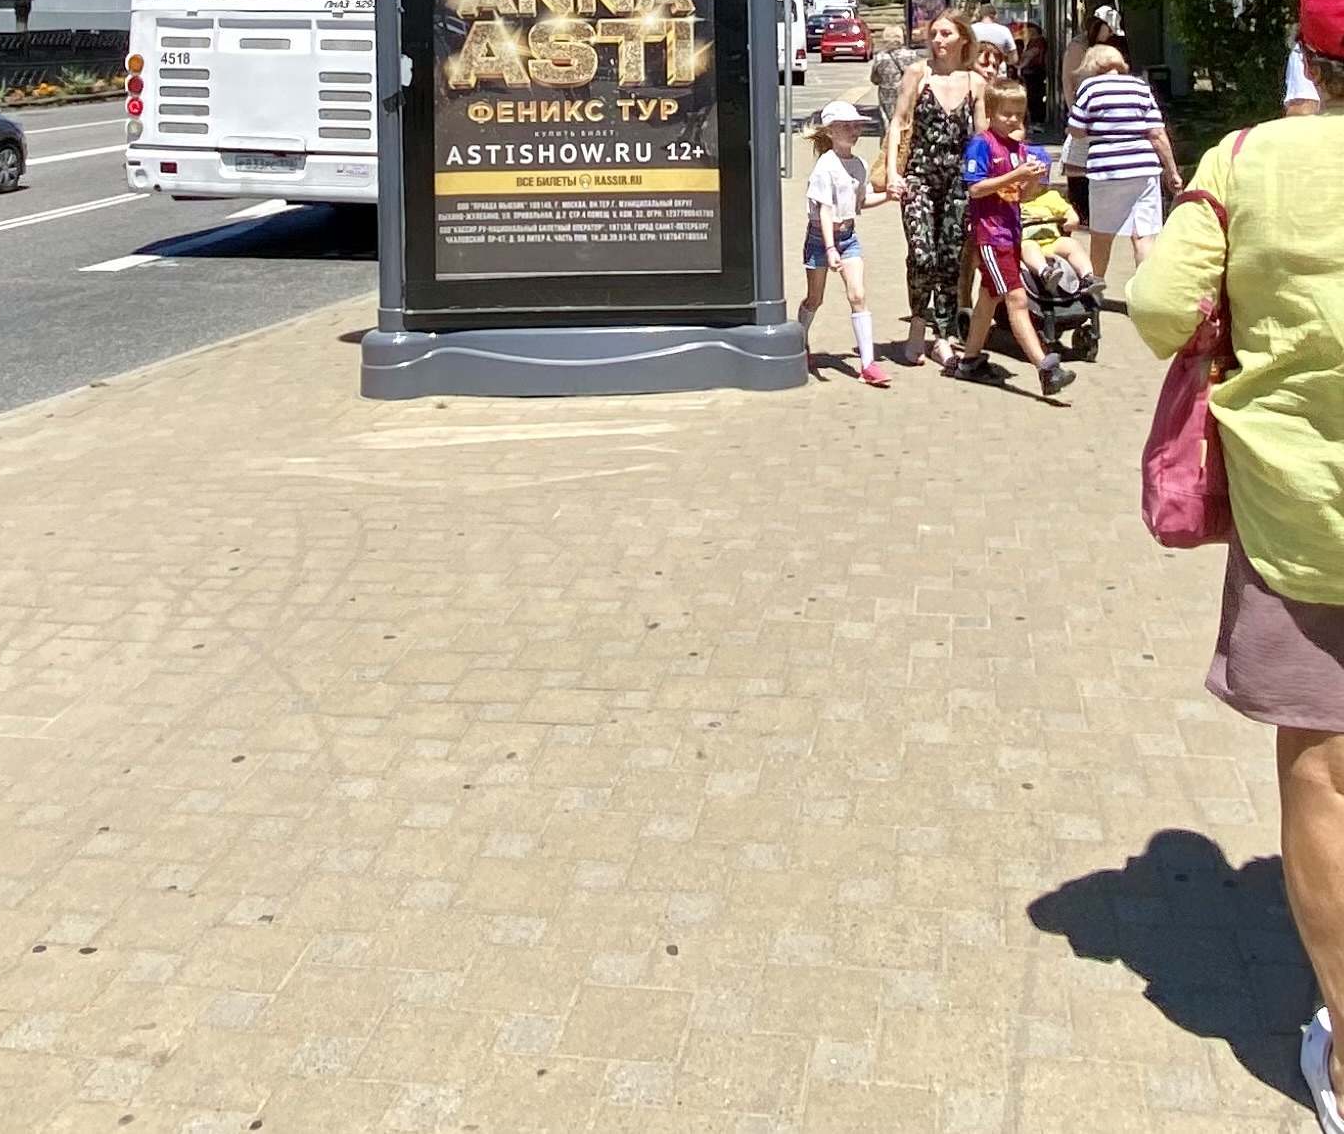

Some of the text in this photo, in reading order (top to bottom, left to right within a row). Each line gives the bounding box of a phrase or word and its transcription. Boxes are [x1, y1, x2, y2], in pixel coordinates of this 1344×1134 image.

[160, 52, 190, 65] 4518
[448, 19, 696, 89] ASTI
[467, 97, 679, 124] ФЕНИКС ТУР
[446, 142, 705, 165] ASTISHOW.RU 12+
[516, 176, 577, 187] ВСЕ БИЛЕТЫ
